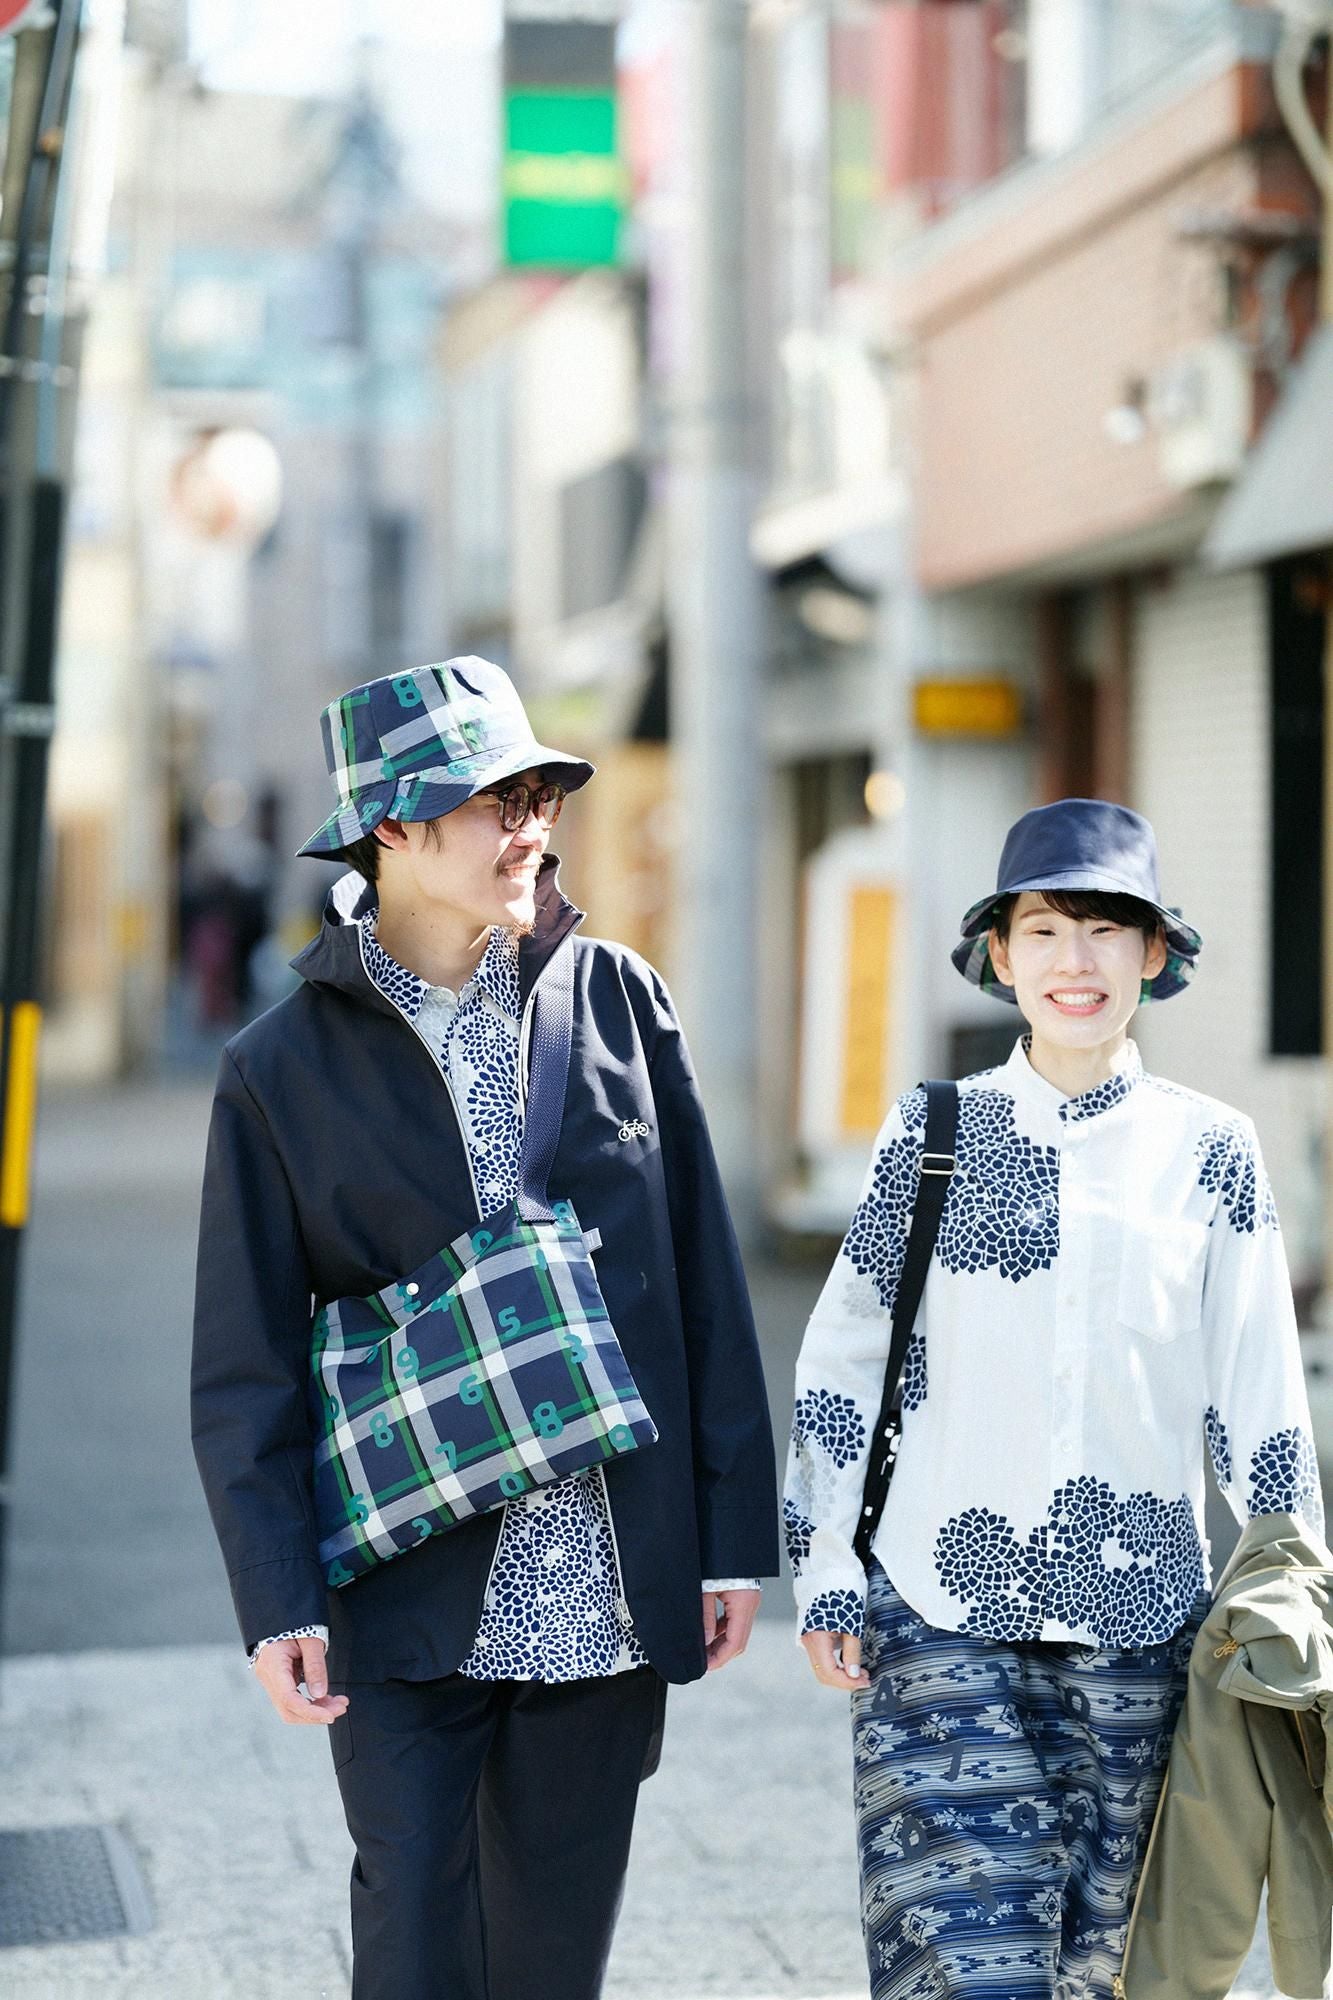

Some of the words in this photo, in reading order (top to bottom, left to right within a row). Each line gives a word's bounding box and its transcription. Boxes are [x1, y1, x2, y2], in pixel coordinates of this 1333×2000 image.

[392, 674, 422, 708] 8
[498, 1305, 521, 1338] 5
[396, 1346, 419, 1379] 9
[563, 1333, 588, 1364] 3
[458, 1374, 483, 1406] 6
[369, 1411, 394, 1448] 8
[533, 1401, 564, 1439] 8
[435, 1440, 457, 1470] 7
[872, 1676, 902, 1717] 4
[938, 1741, 965, 1782] 7
[1010, 1802, 1040, 1846] 9
[969, 1870, 999, 1918] 3
